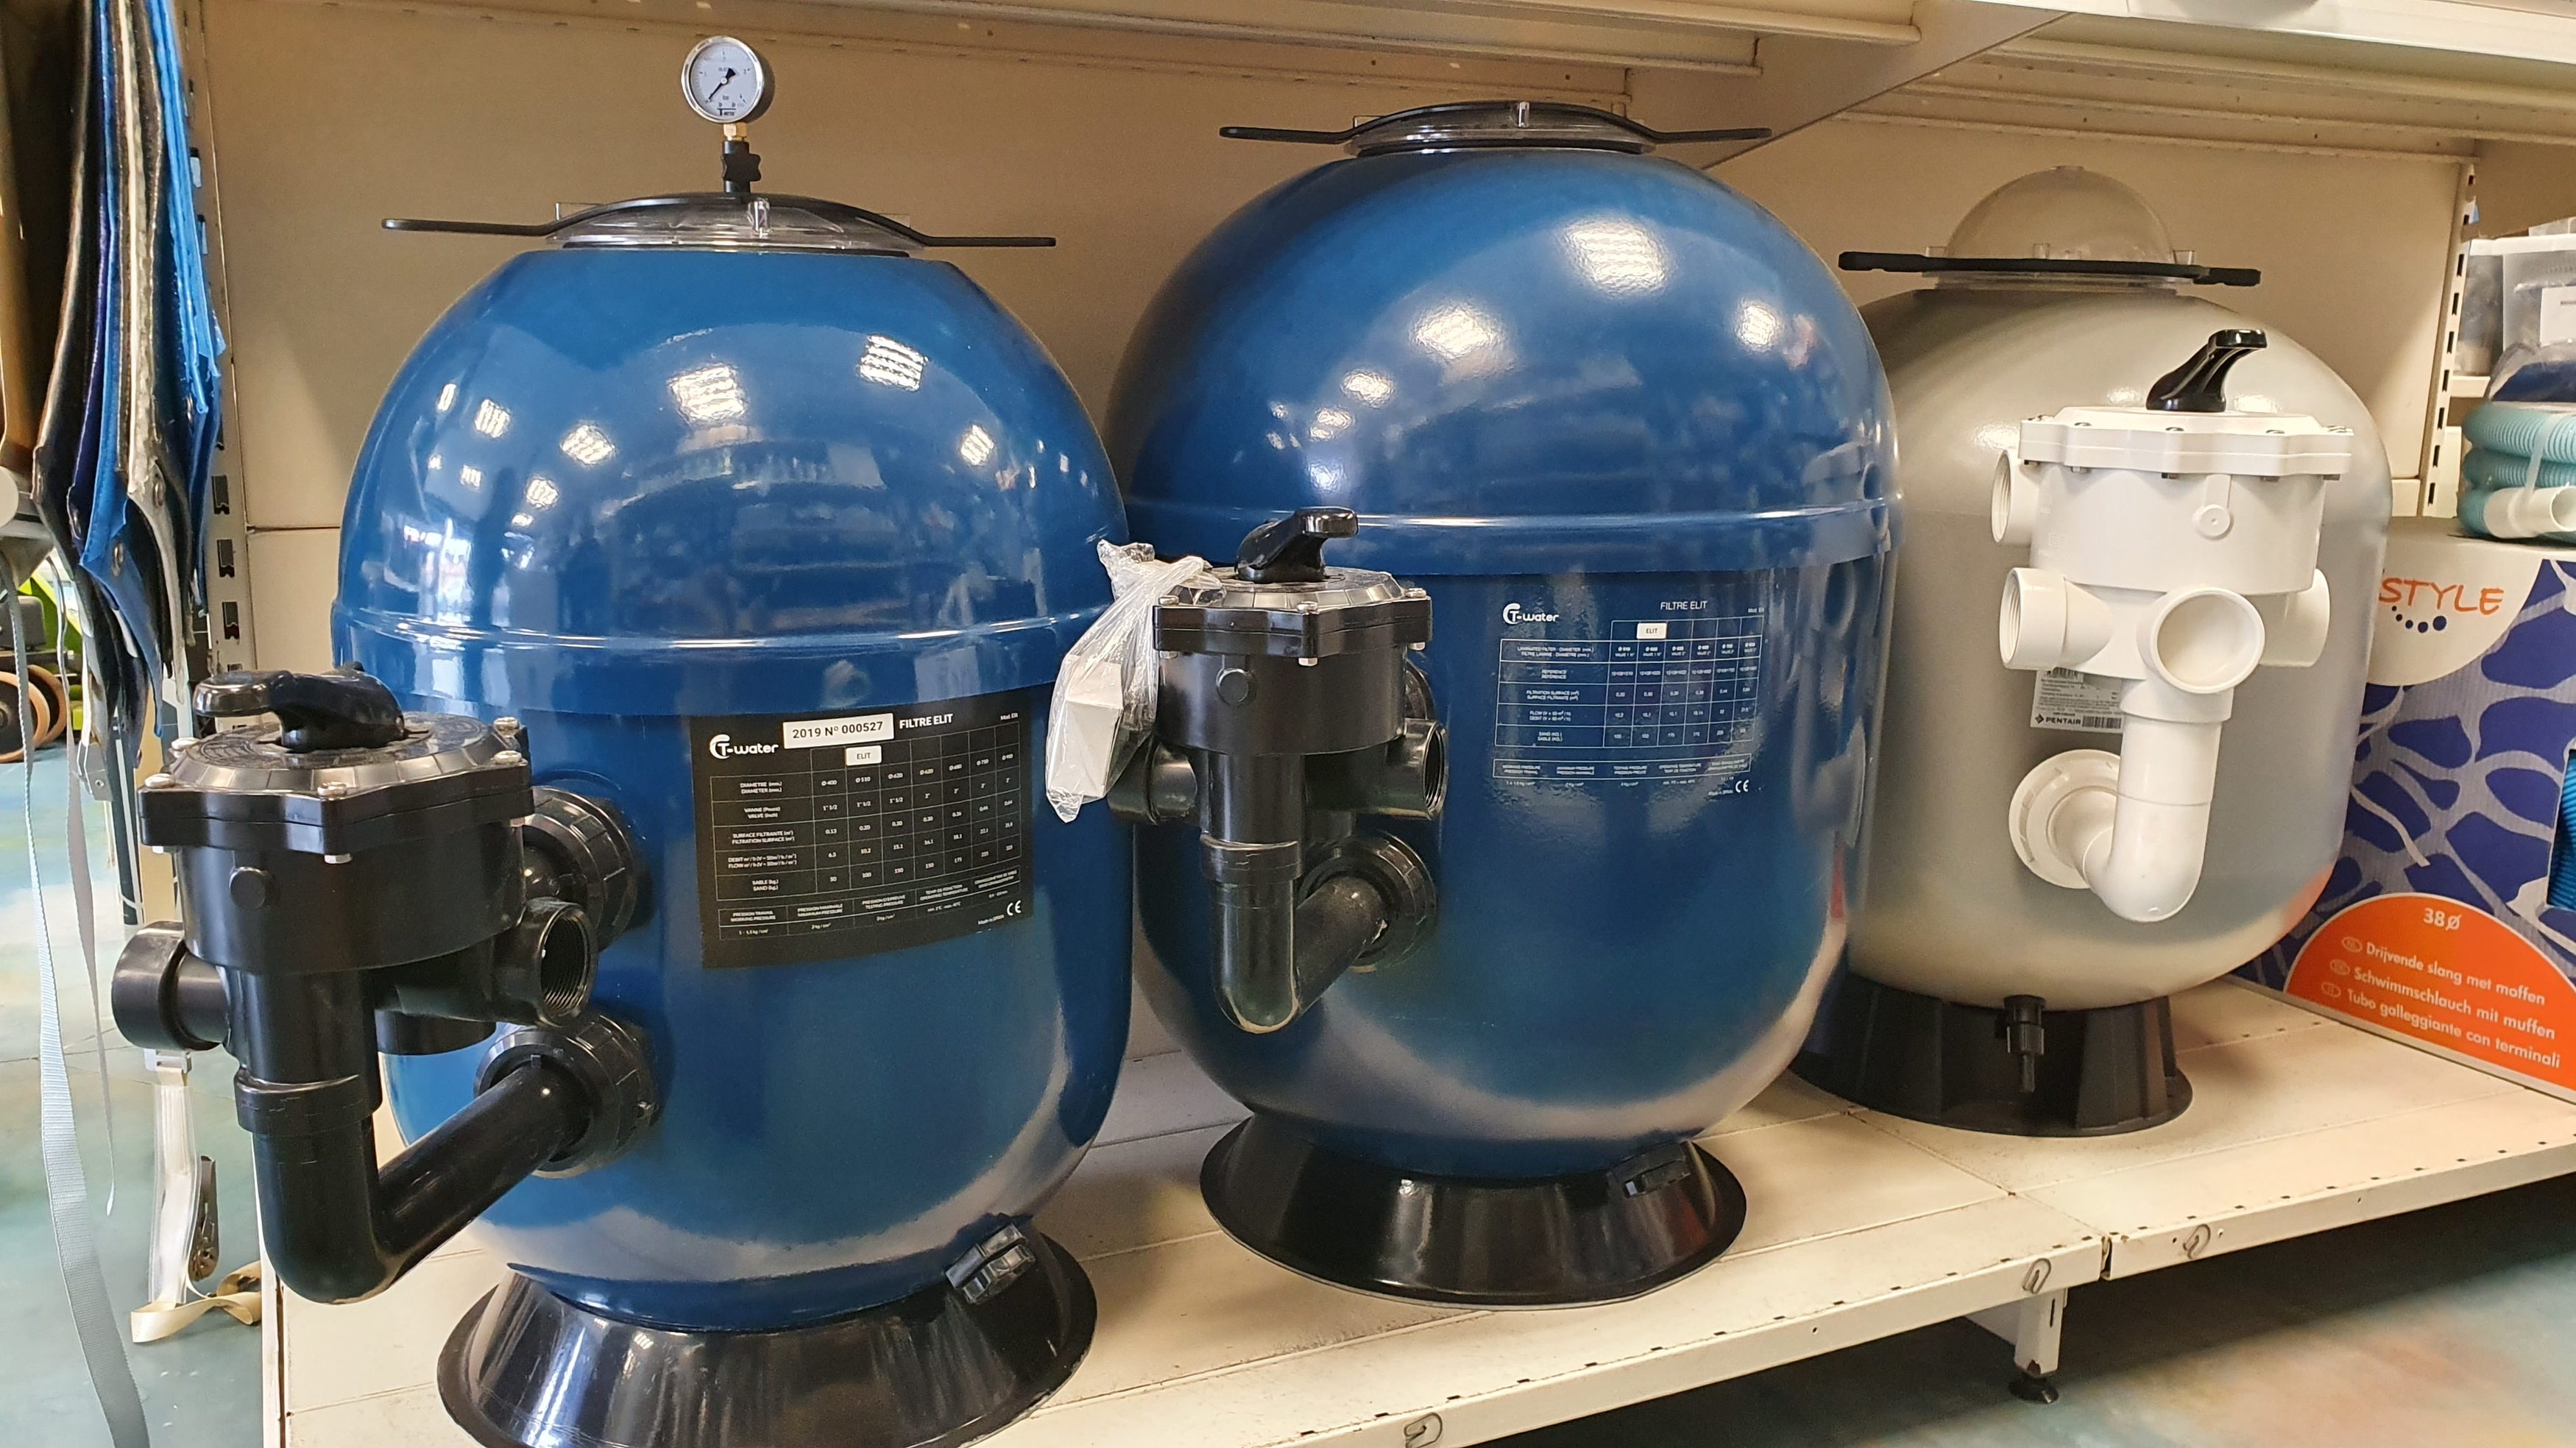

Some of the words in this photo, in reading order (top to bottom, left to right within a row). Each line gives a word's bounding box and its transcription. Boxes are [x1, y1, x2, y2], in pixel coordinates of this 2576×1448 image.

[2379, 577, 2505, 615] STYLE
[1660, 601, 1688, 611] FILTRE
[1690, 600, 1708, 610] ELIT
[792, 728, 821, 739] 2019
[841, 721, 883, 734] 000527
[899, 716, 933, 729] FILTRE
[933, 714, 953, 724] ELIT
[2046, 717, 2081, 725] PENTAIR
[857, 752, 871, 760] ELIT
[2366, 941, 2424, 971] Drijvende
[2427, 960, 2462, 985] slang
[2466, 975, 2492, 990] met
[2496, 984, 2545, 1006] moffen
[2354, 967, 2471, 1015] Schwimmschlauch
[2477, 1007, 2499, 1023] mit
[2503, 1017, 2555, 1040] muffen
[2347, 987, 2377, 1009] Tubo
[2379, 1003, 2462, 1037] galleggiante
[2466, 1031, 2491, 1046] con
[2496, 1037, 2561, 1069] terminali
